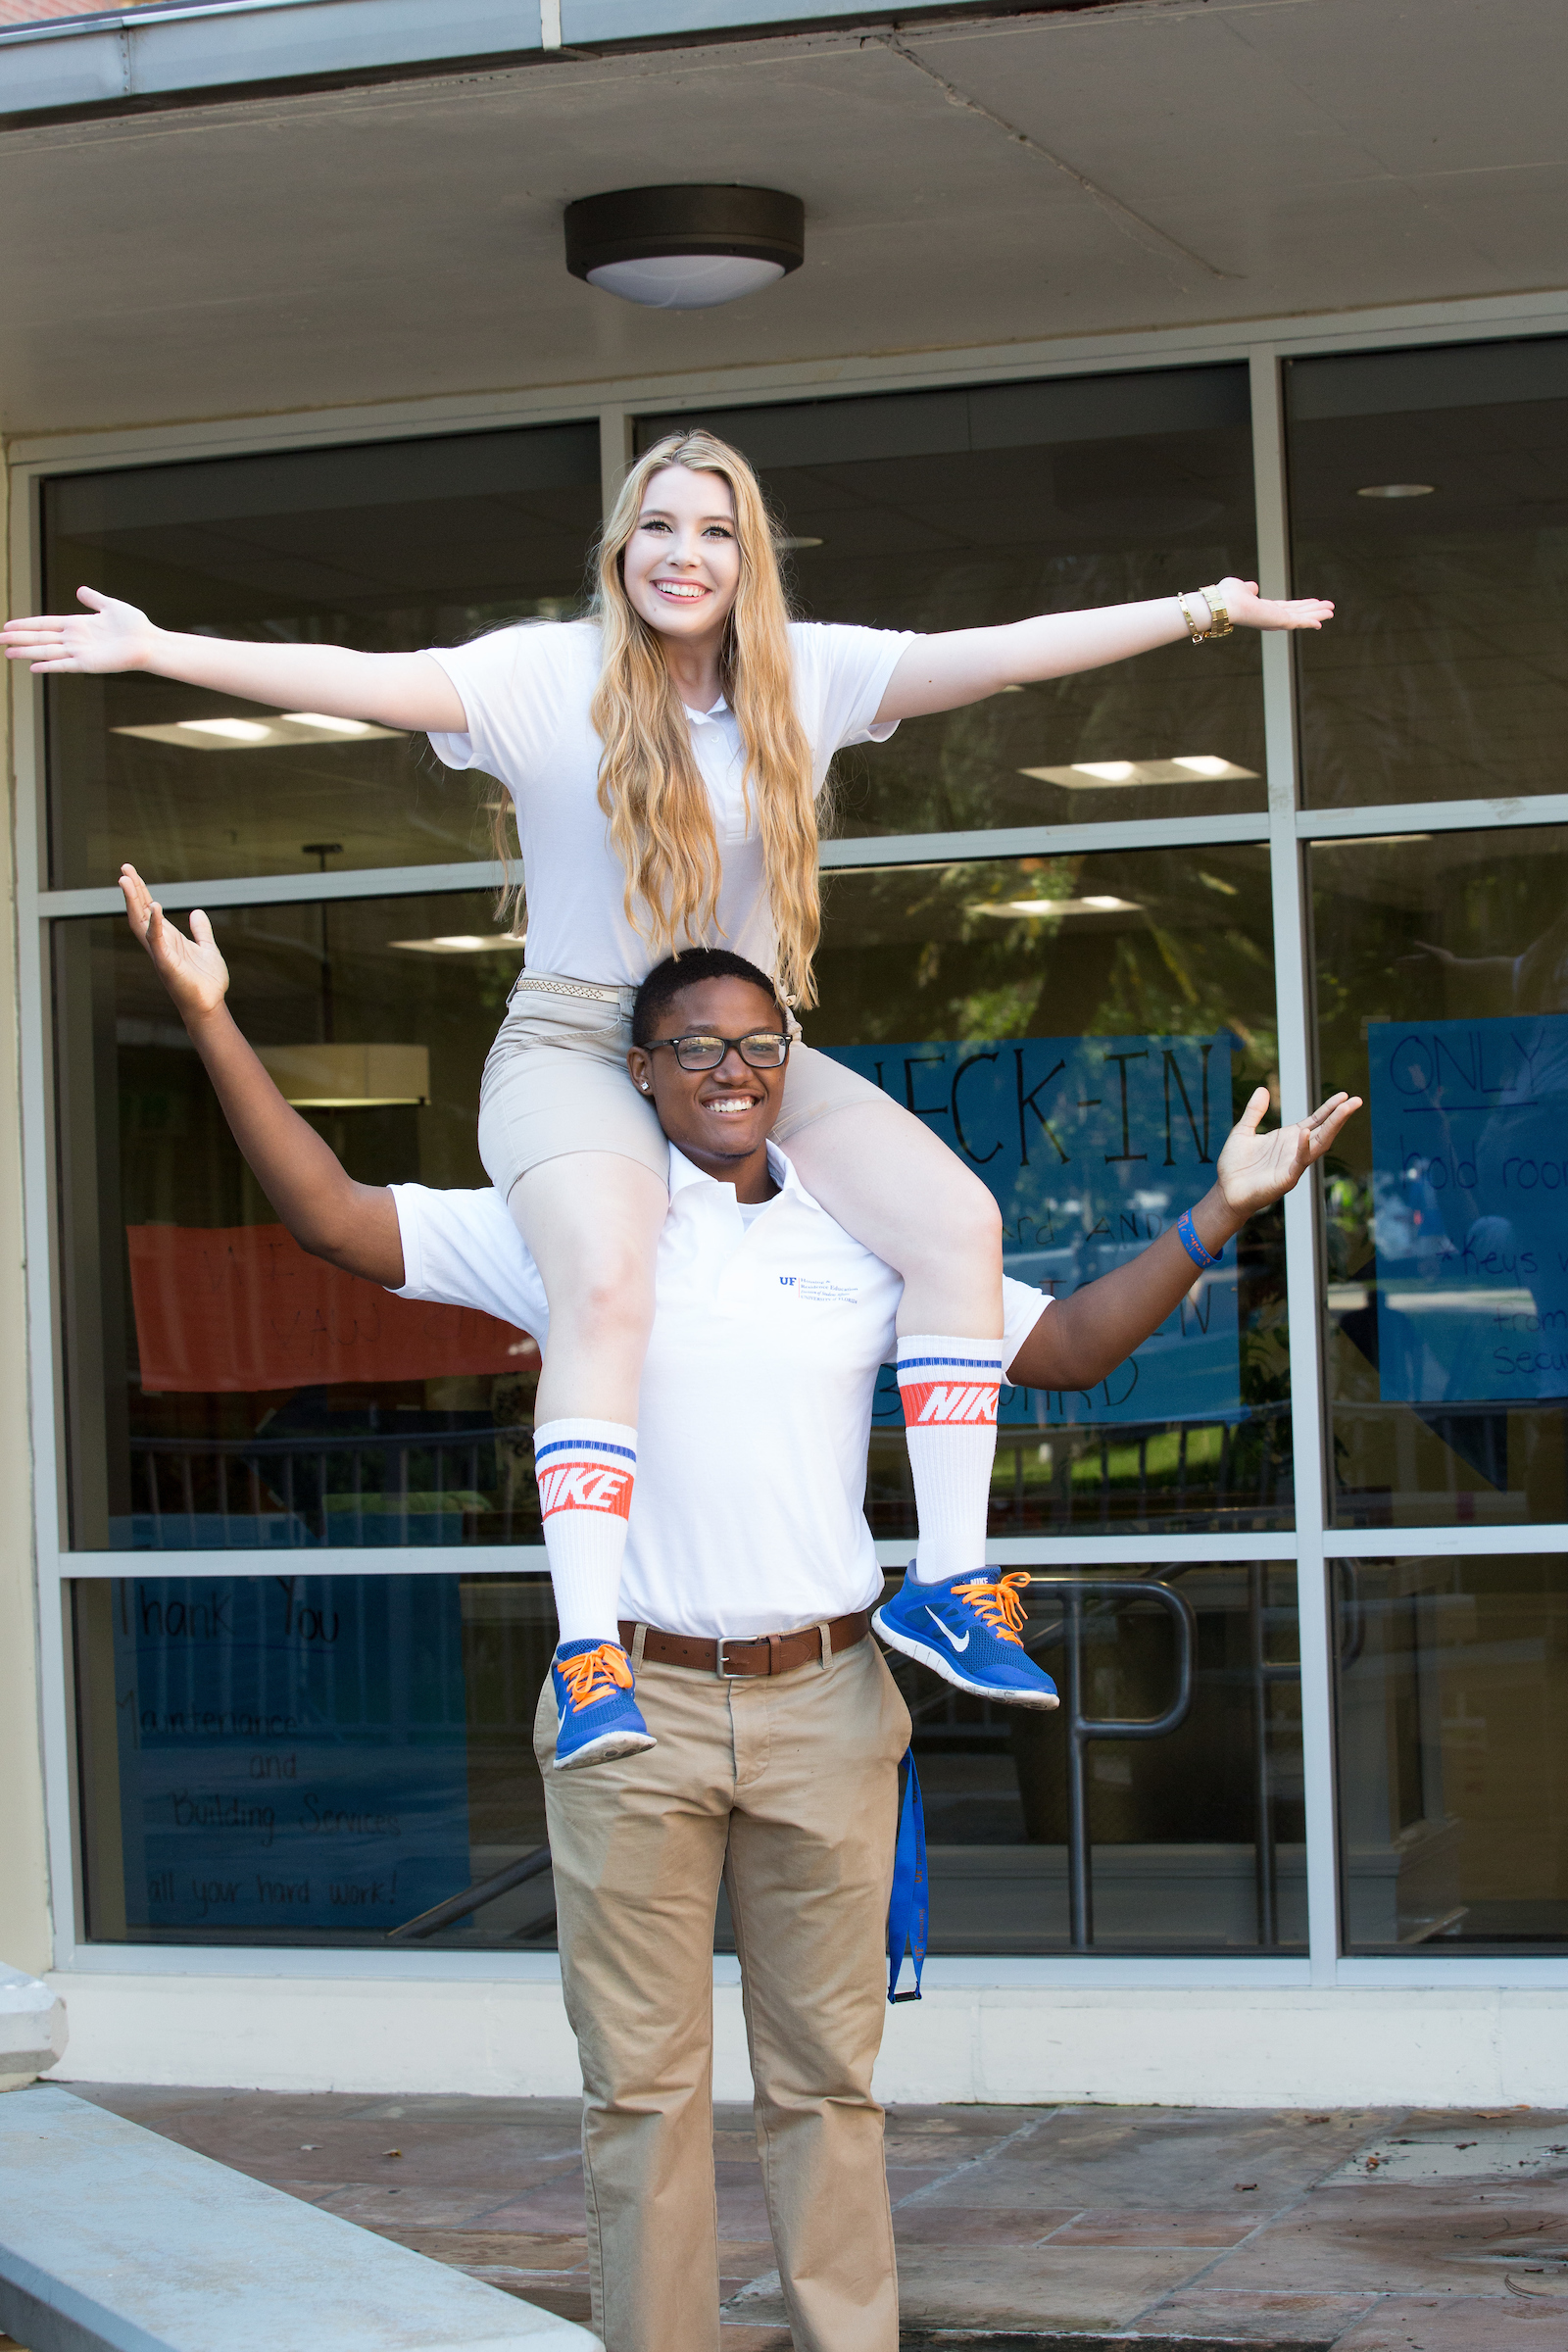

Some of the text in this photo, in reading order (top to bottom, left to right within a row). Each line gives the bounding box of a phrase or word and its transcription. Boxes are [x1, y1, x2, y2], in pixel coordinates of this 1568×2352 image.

[1389, 1025, 1545, 1096] ONLY
[873, 1044, 1213, 1167] ECK-IN
[1399, 1134, 1479, 1191] hold
[1085, 1211, 1163, 1244] AND
[779, 1276, 798, 1287] UF
[1493, 1300, 1568, 1334] from
[1493, 1346, 1568, 1375] Secu
[917, 1385, 1000, 1422] NIK
[275, 1576, 340, 1643] You
[249, 1752, 297, 1782] and
[169, 1789, 402, 1847] Building Services
[148, 1870, 175, 1903] all
[191, 1877, 243, 1919] your
[256, 1873, 312, 1904] hard
